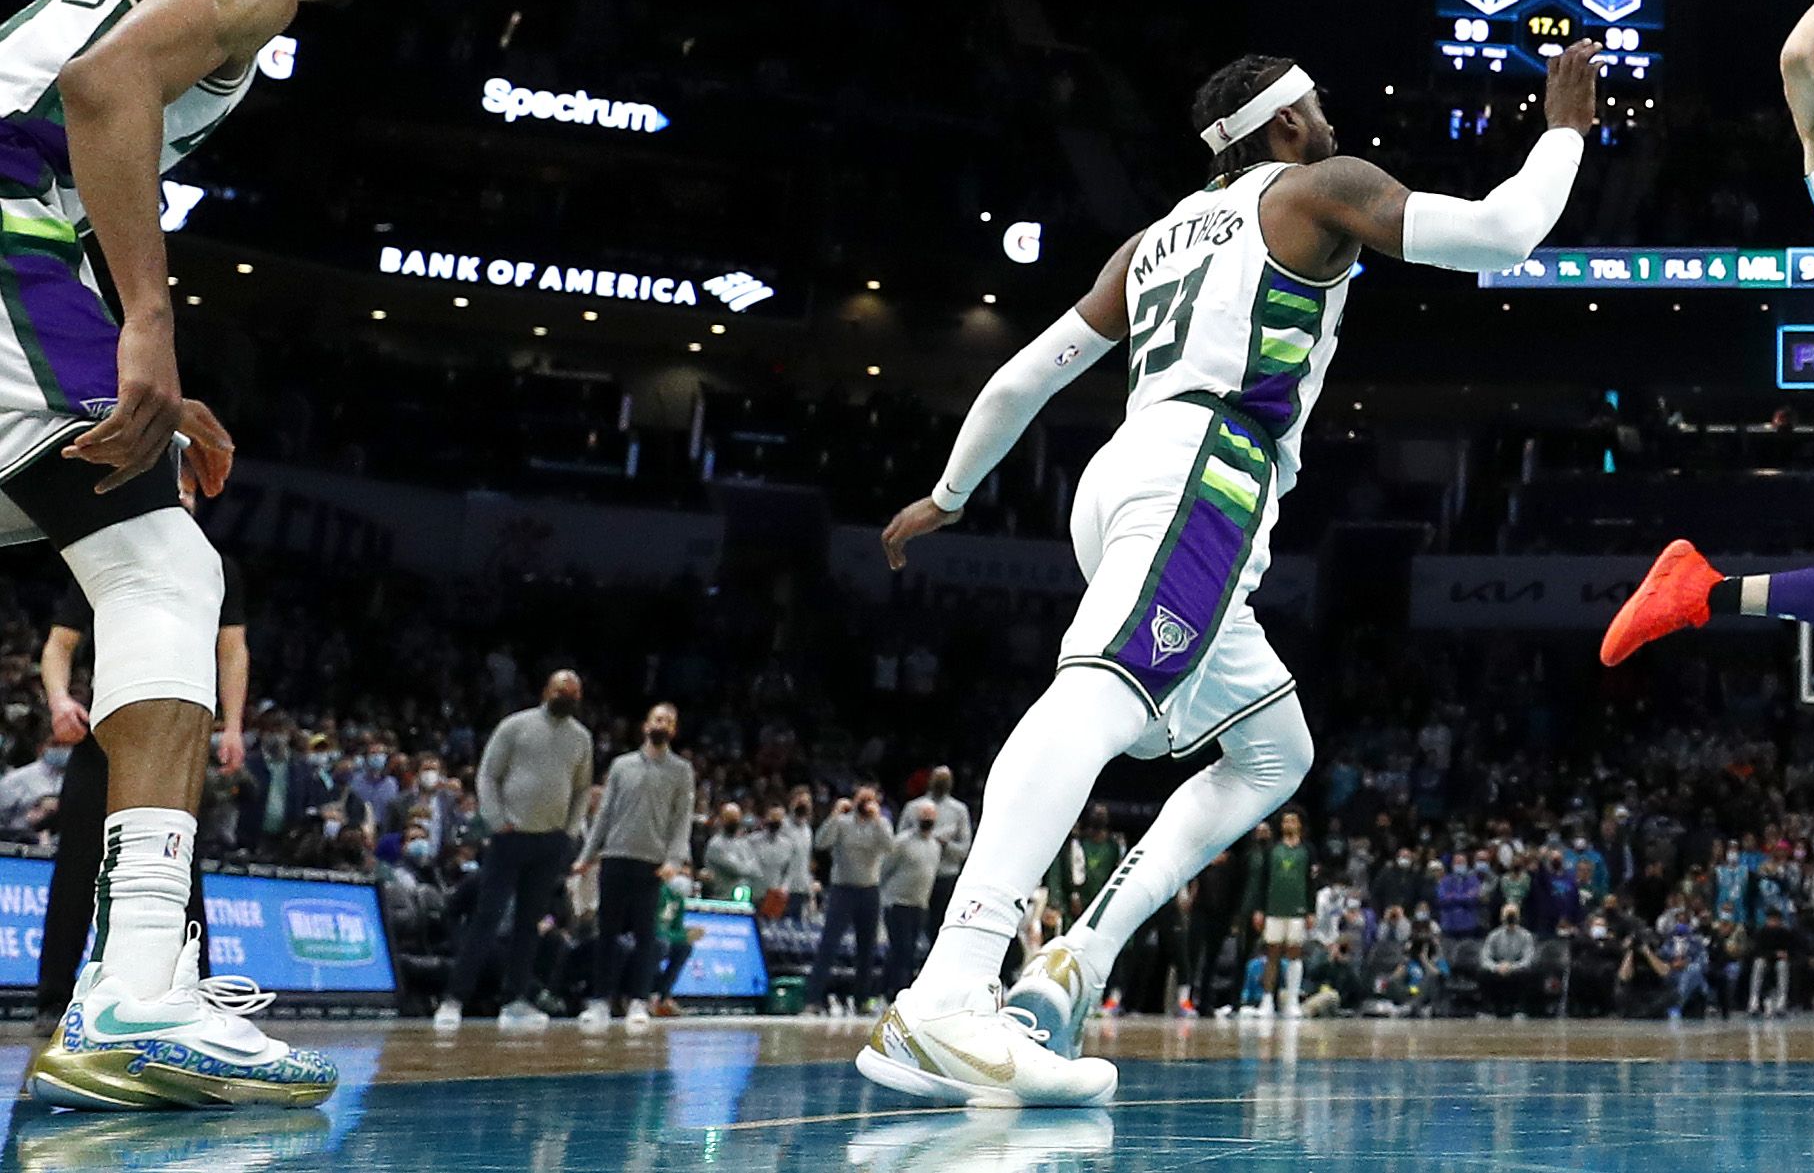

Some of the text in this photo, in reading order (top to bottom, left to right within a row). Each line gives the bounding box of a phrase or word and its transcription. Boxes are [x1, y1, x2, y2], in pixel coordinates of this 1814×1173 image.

[1528, 17, 1570, 36] 17.1
[482, 78, 658, 133] Spectrum
[380, 247, 697, 306] BANK OF AMERICA
[1590, 259, 1631, 280] TOL
[1638, 258, 1650, 279] 1
[1665, 259, 1703, 280] FLS
[1708, 258, 1727, 280] 4
[1737, 256, 1786, 281] MIL
